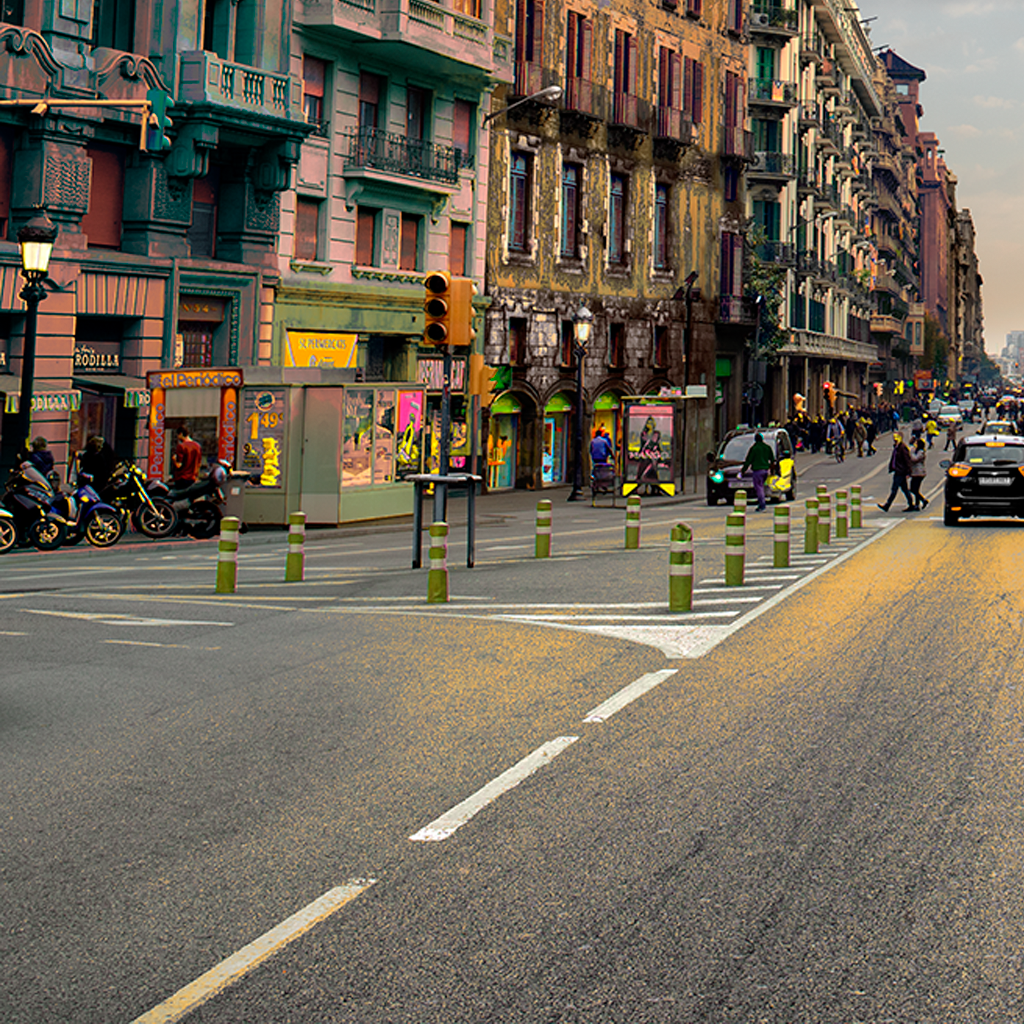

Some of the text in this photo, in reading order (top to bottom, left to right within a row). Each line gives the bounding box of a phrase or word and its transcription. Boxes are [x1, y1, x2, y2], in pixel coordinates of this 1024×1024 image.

[74, 354, 119, 367] RODILLA
[162, 372, 241, 388] el Periódico
[222, 401, 236, 463] eriódico
